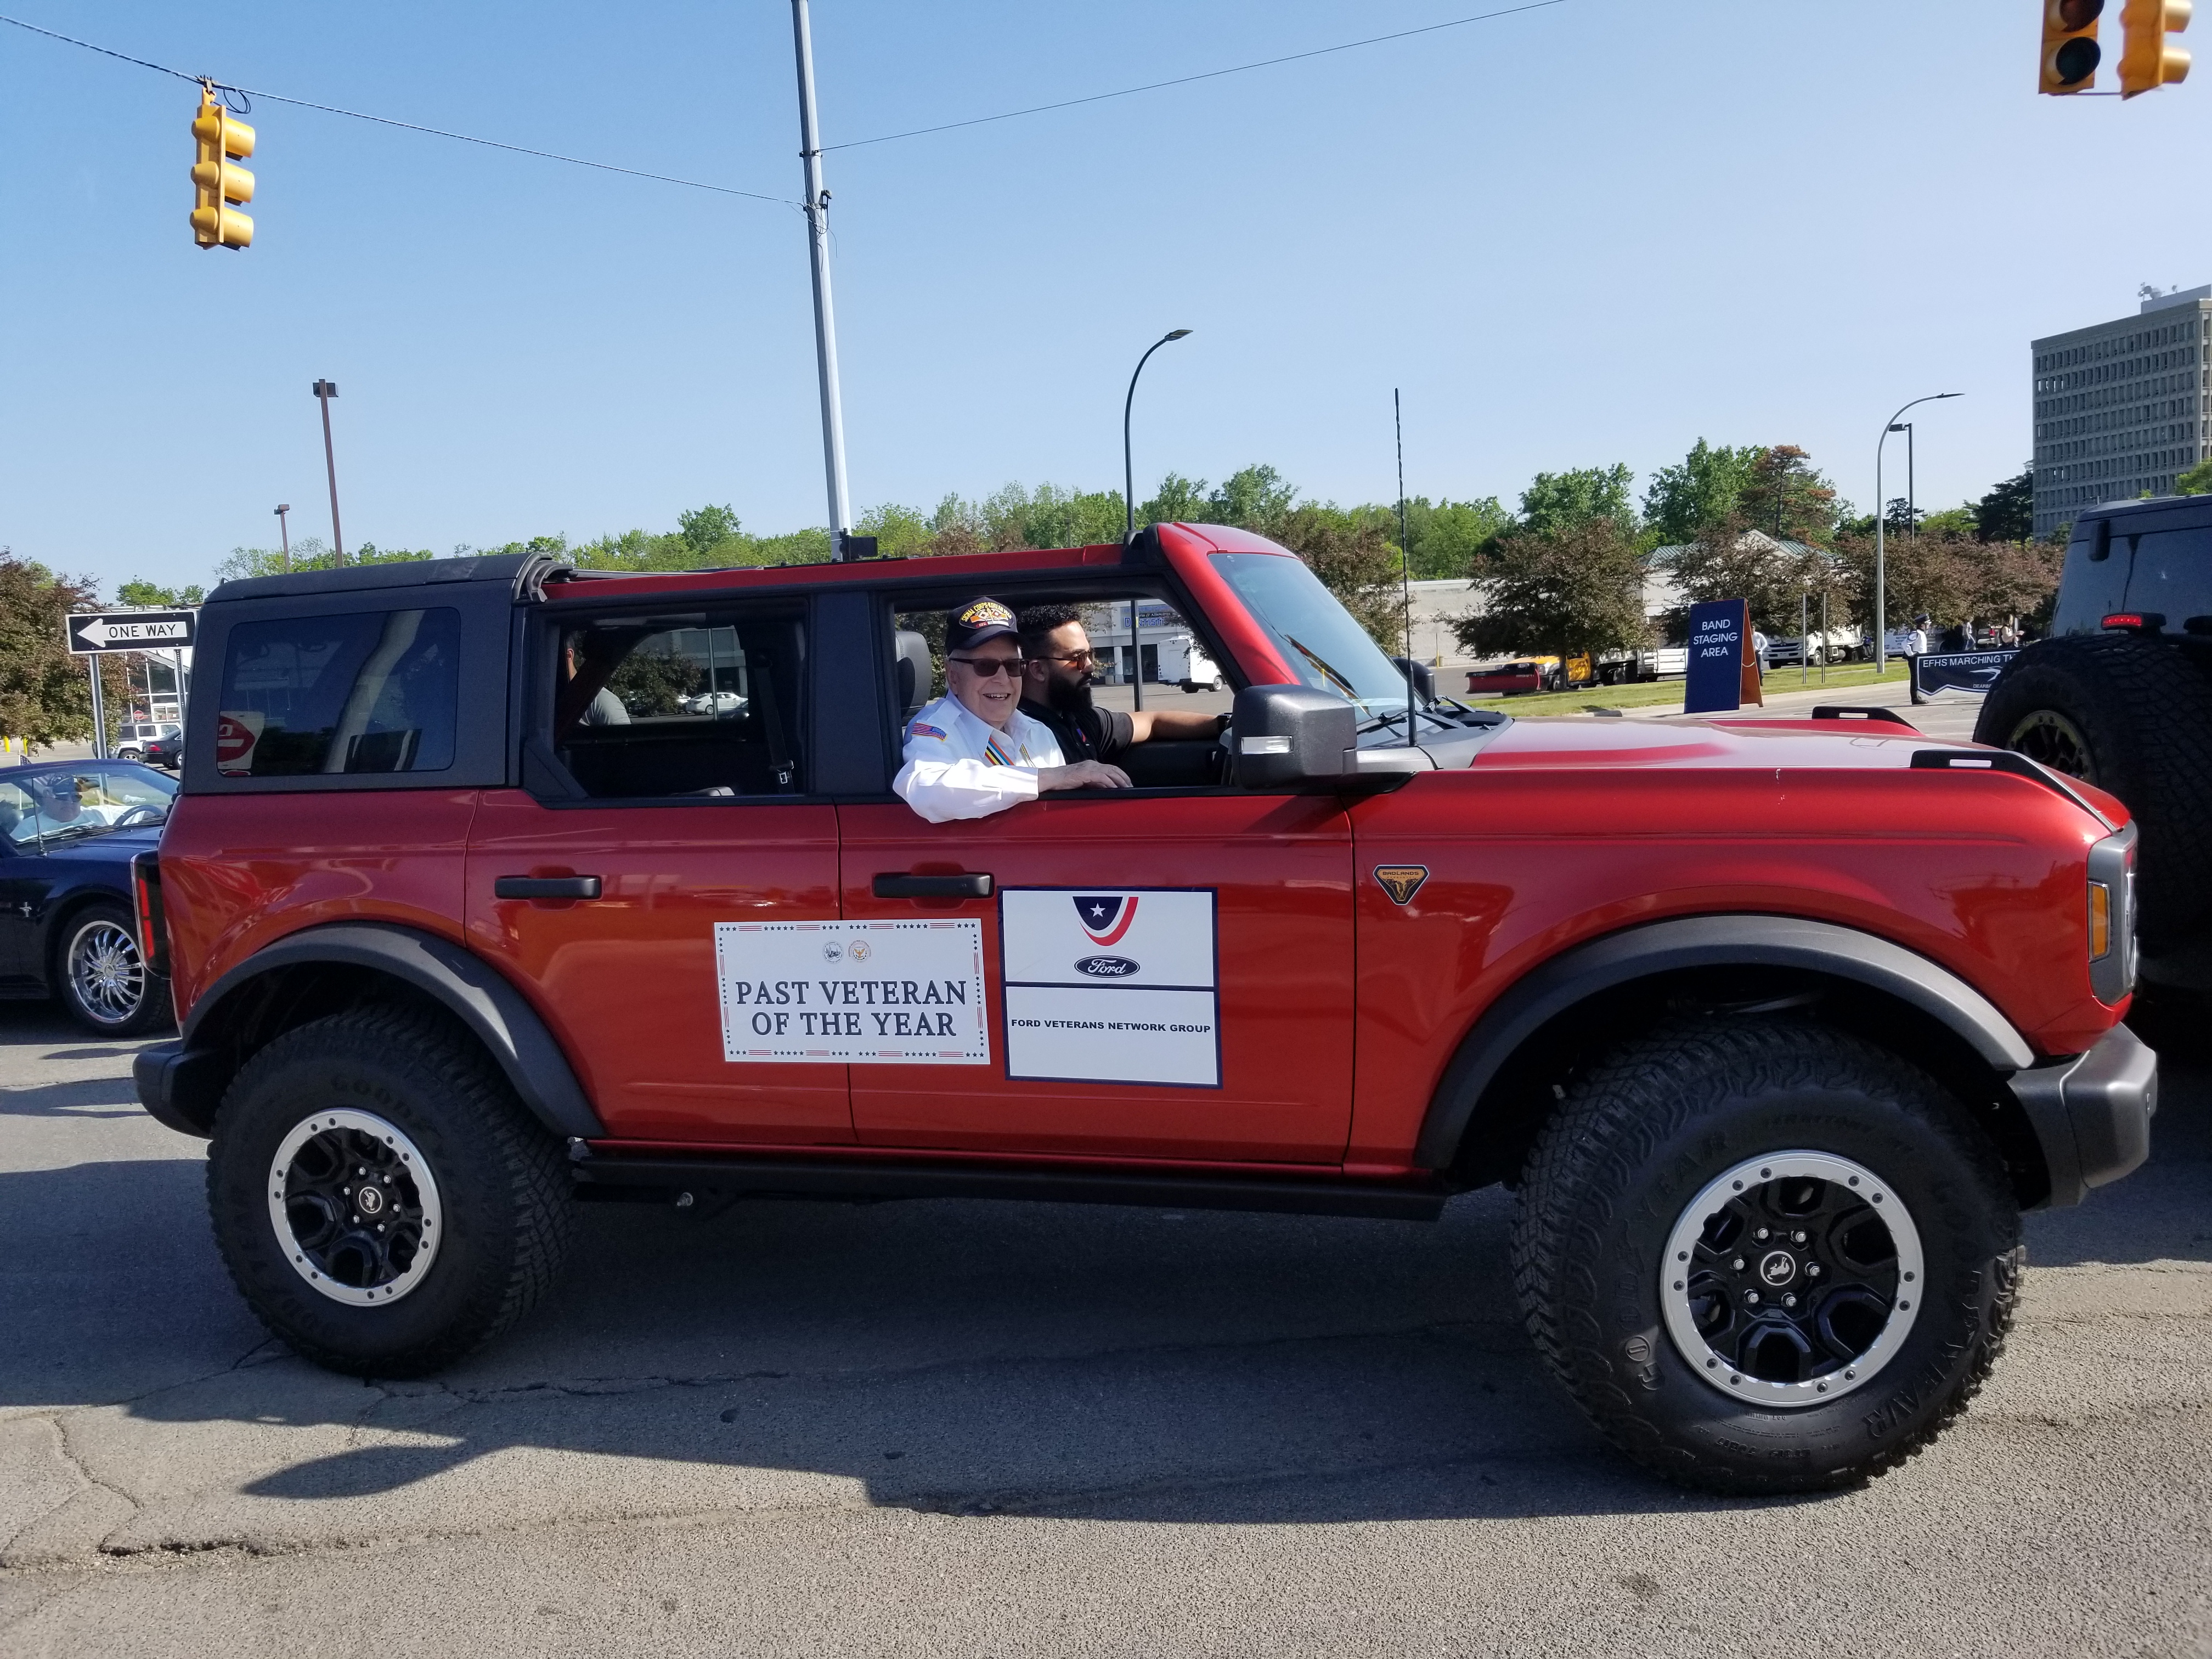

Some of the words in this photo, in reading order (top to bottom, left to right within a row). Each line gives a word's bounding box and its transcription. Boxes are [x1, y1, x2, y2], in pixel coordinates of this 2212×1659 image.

[109, 625, 140, 638] ONE
[145, 624, 176, 636] WAY
[1702, 619, 1730, 630] BAND
[1693, 632, 1738, 645] STAGING
[1701, 646, 1728, 658] AREA
[1923, 658, 1948, 668] EFHS
[1949, 655, 2001, 666] MARCHING
[1087, 958, 1127, 974] Ford
[736, 980, 809, 1005] PAST
[819, 980, 967, 1005] VETERAN
[752, 1012, 789, 1036] OF
[800, 1012, 862, 1036] THE
[871, 1012, 956, 1036] YEAR
[1011, 1019, 1041, 1028] FORD
[1044, 1020, 1104, 1030] VETERANS
[1108, 1022, 1166, 1031] NETWORK
[1170, 1024, 1211, 1033] GROUP
